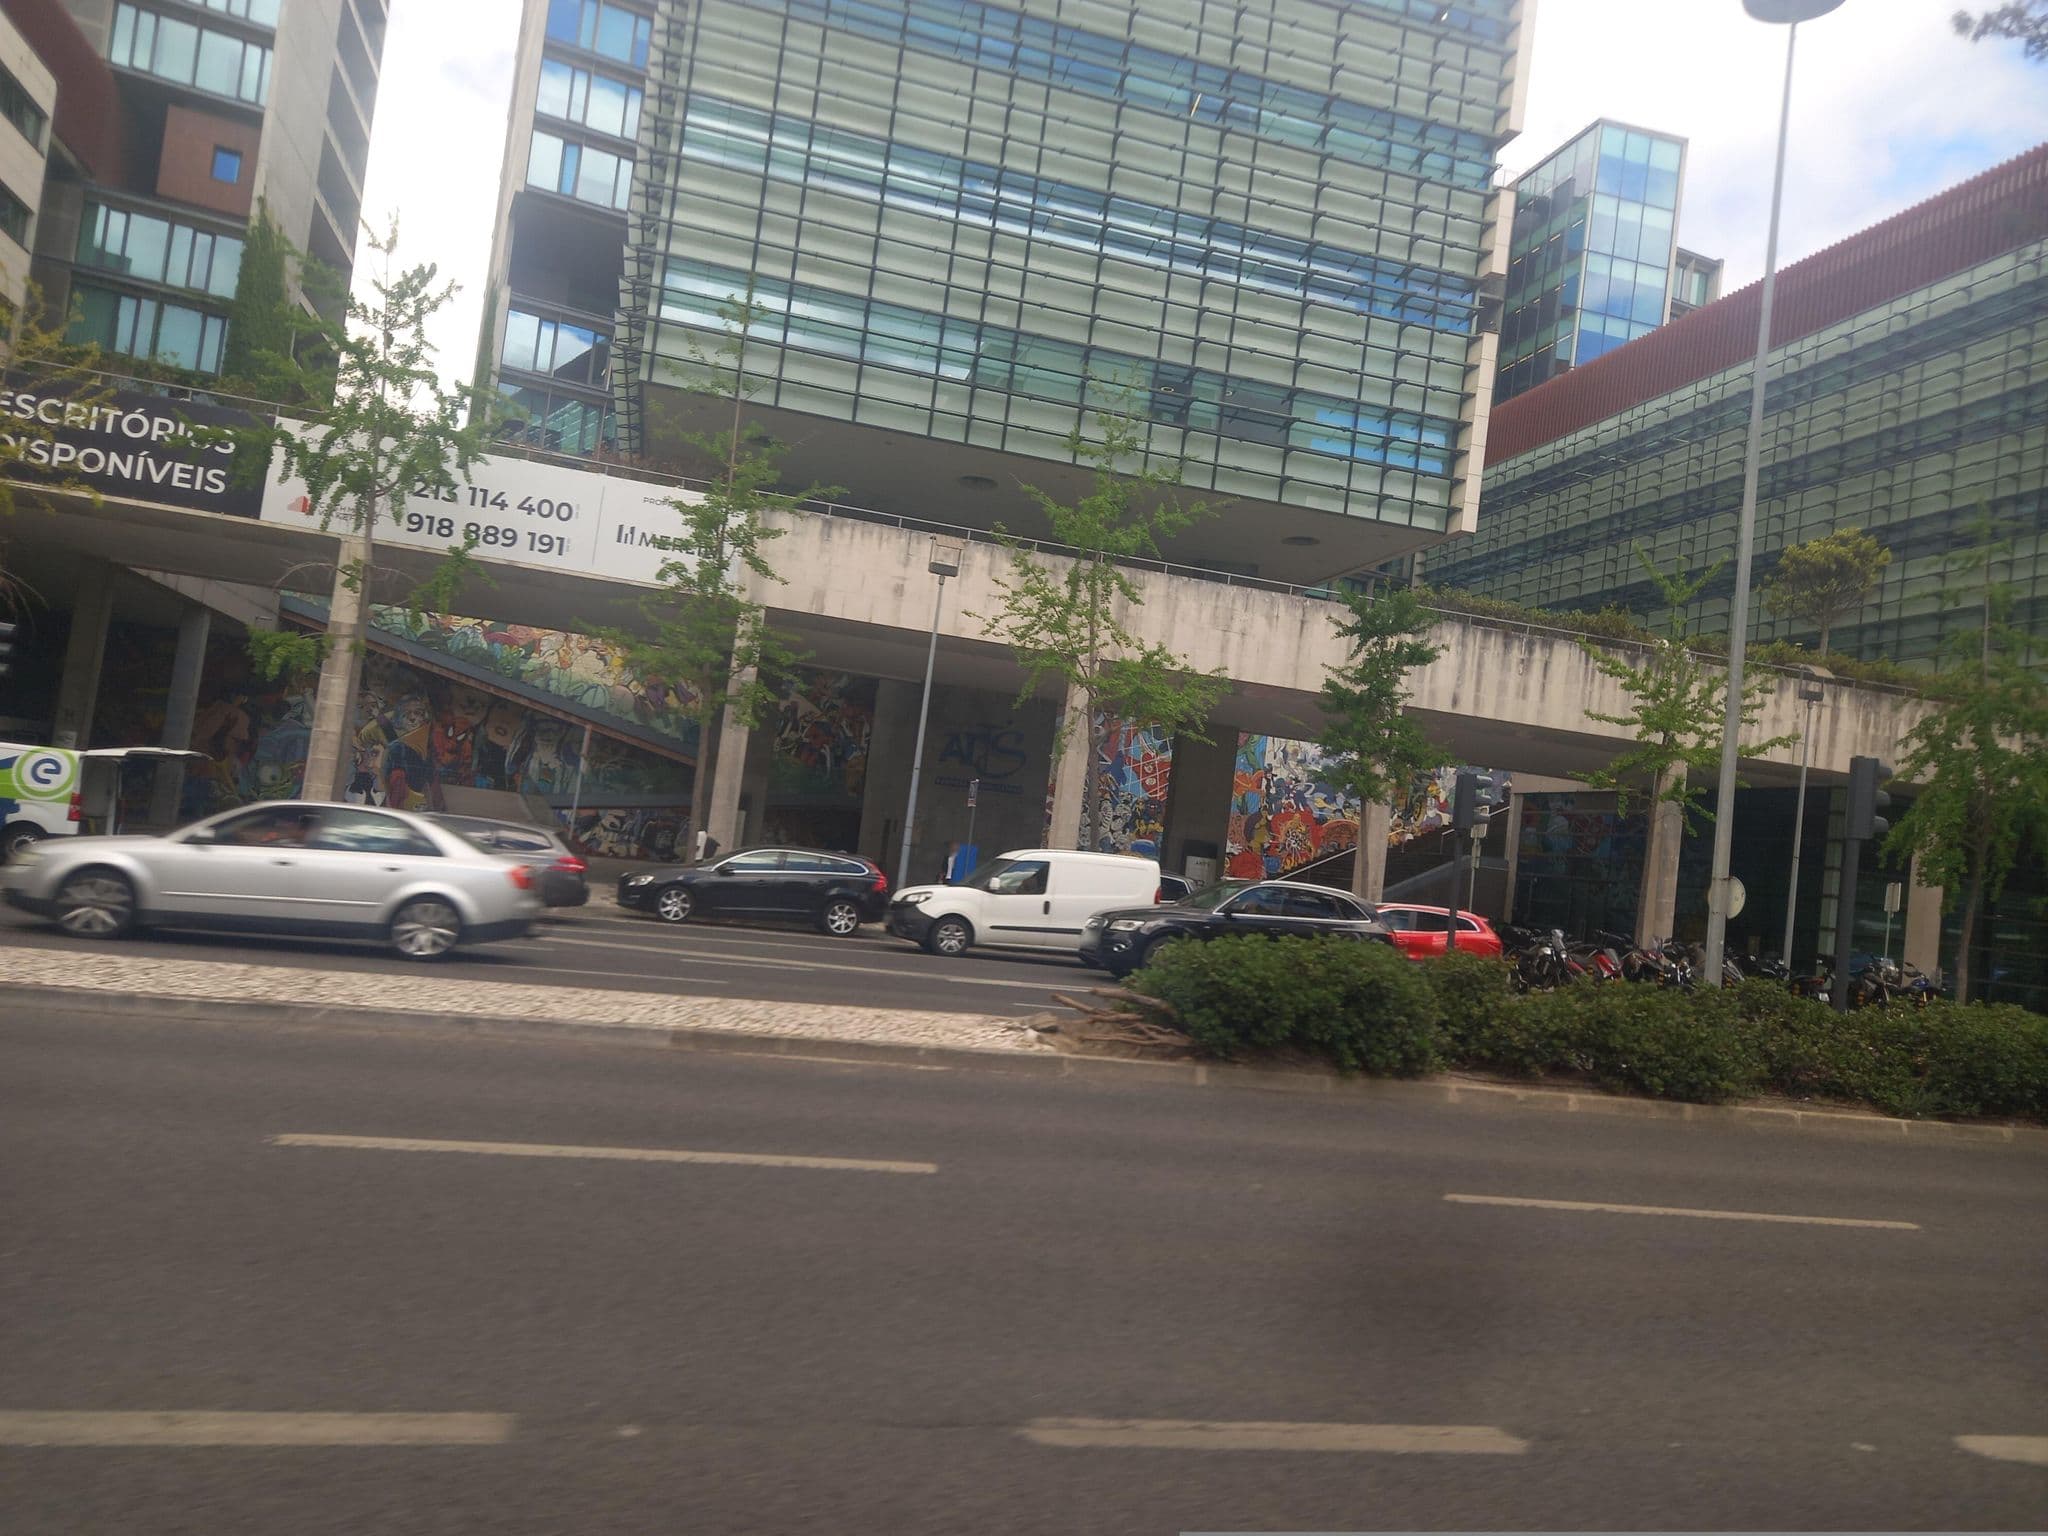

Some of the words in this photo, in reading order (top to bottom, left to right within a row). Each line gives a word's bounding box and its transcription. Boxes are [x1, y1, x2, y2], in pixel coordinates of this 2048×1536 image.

[468, 486, 508, 511] 114
[517, 496, 573, 522] 400
[406, 512, 454, 538] 918
[464, 521, 518, 548] 889
[527, 531, 565, 556] 191
